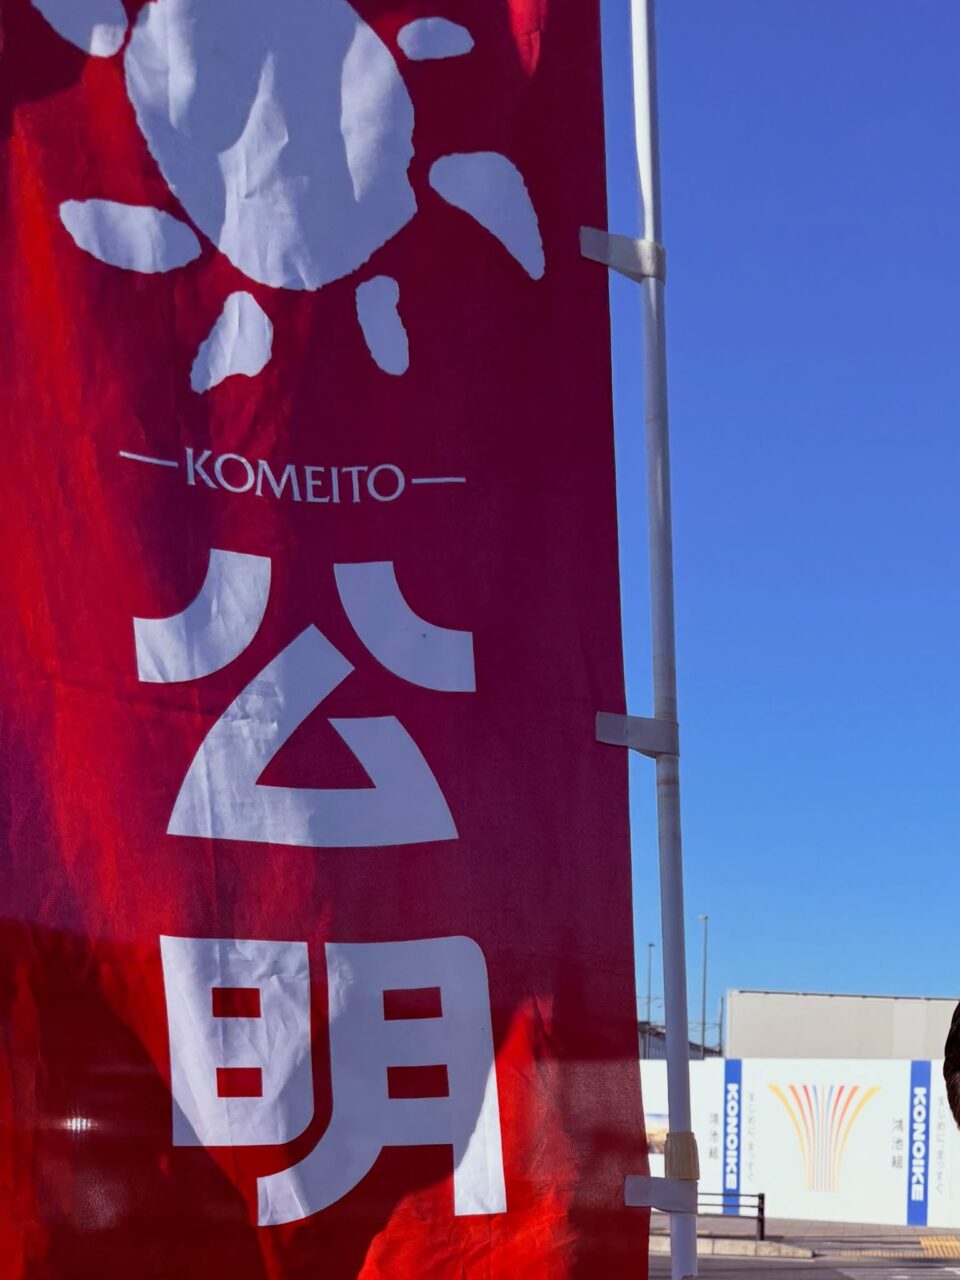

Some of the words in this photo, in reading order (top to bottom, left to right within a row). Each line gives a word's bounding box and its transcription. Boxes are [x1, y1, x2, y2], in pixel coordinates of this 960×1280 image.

[185, 447, 406, 504] KOMEITO
[725, 1082, 740, 1190] KONOIKE
[910, 1086, 928, 1202] KONOIKE
